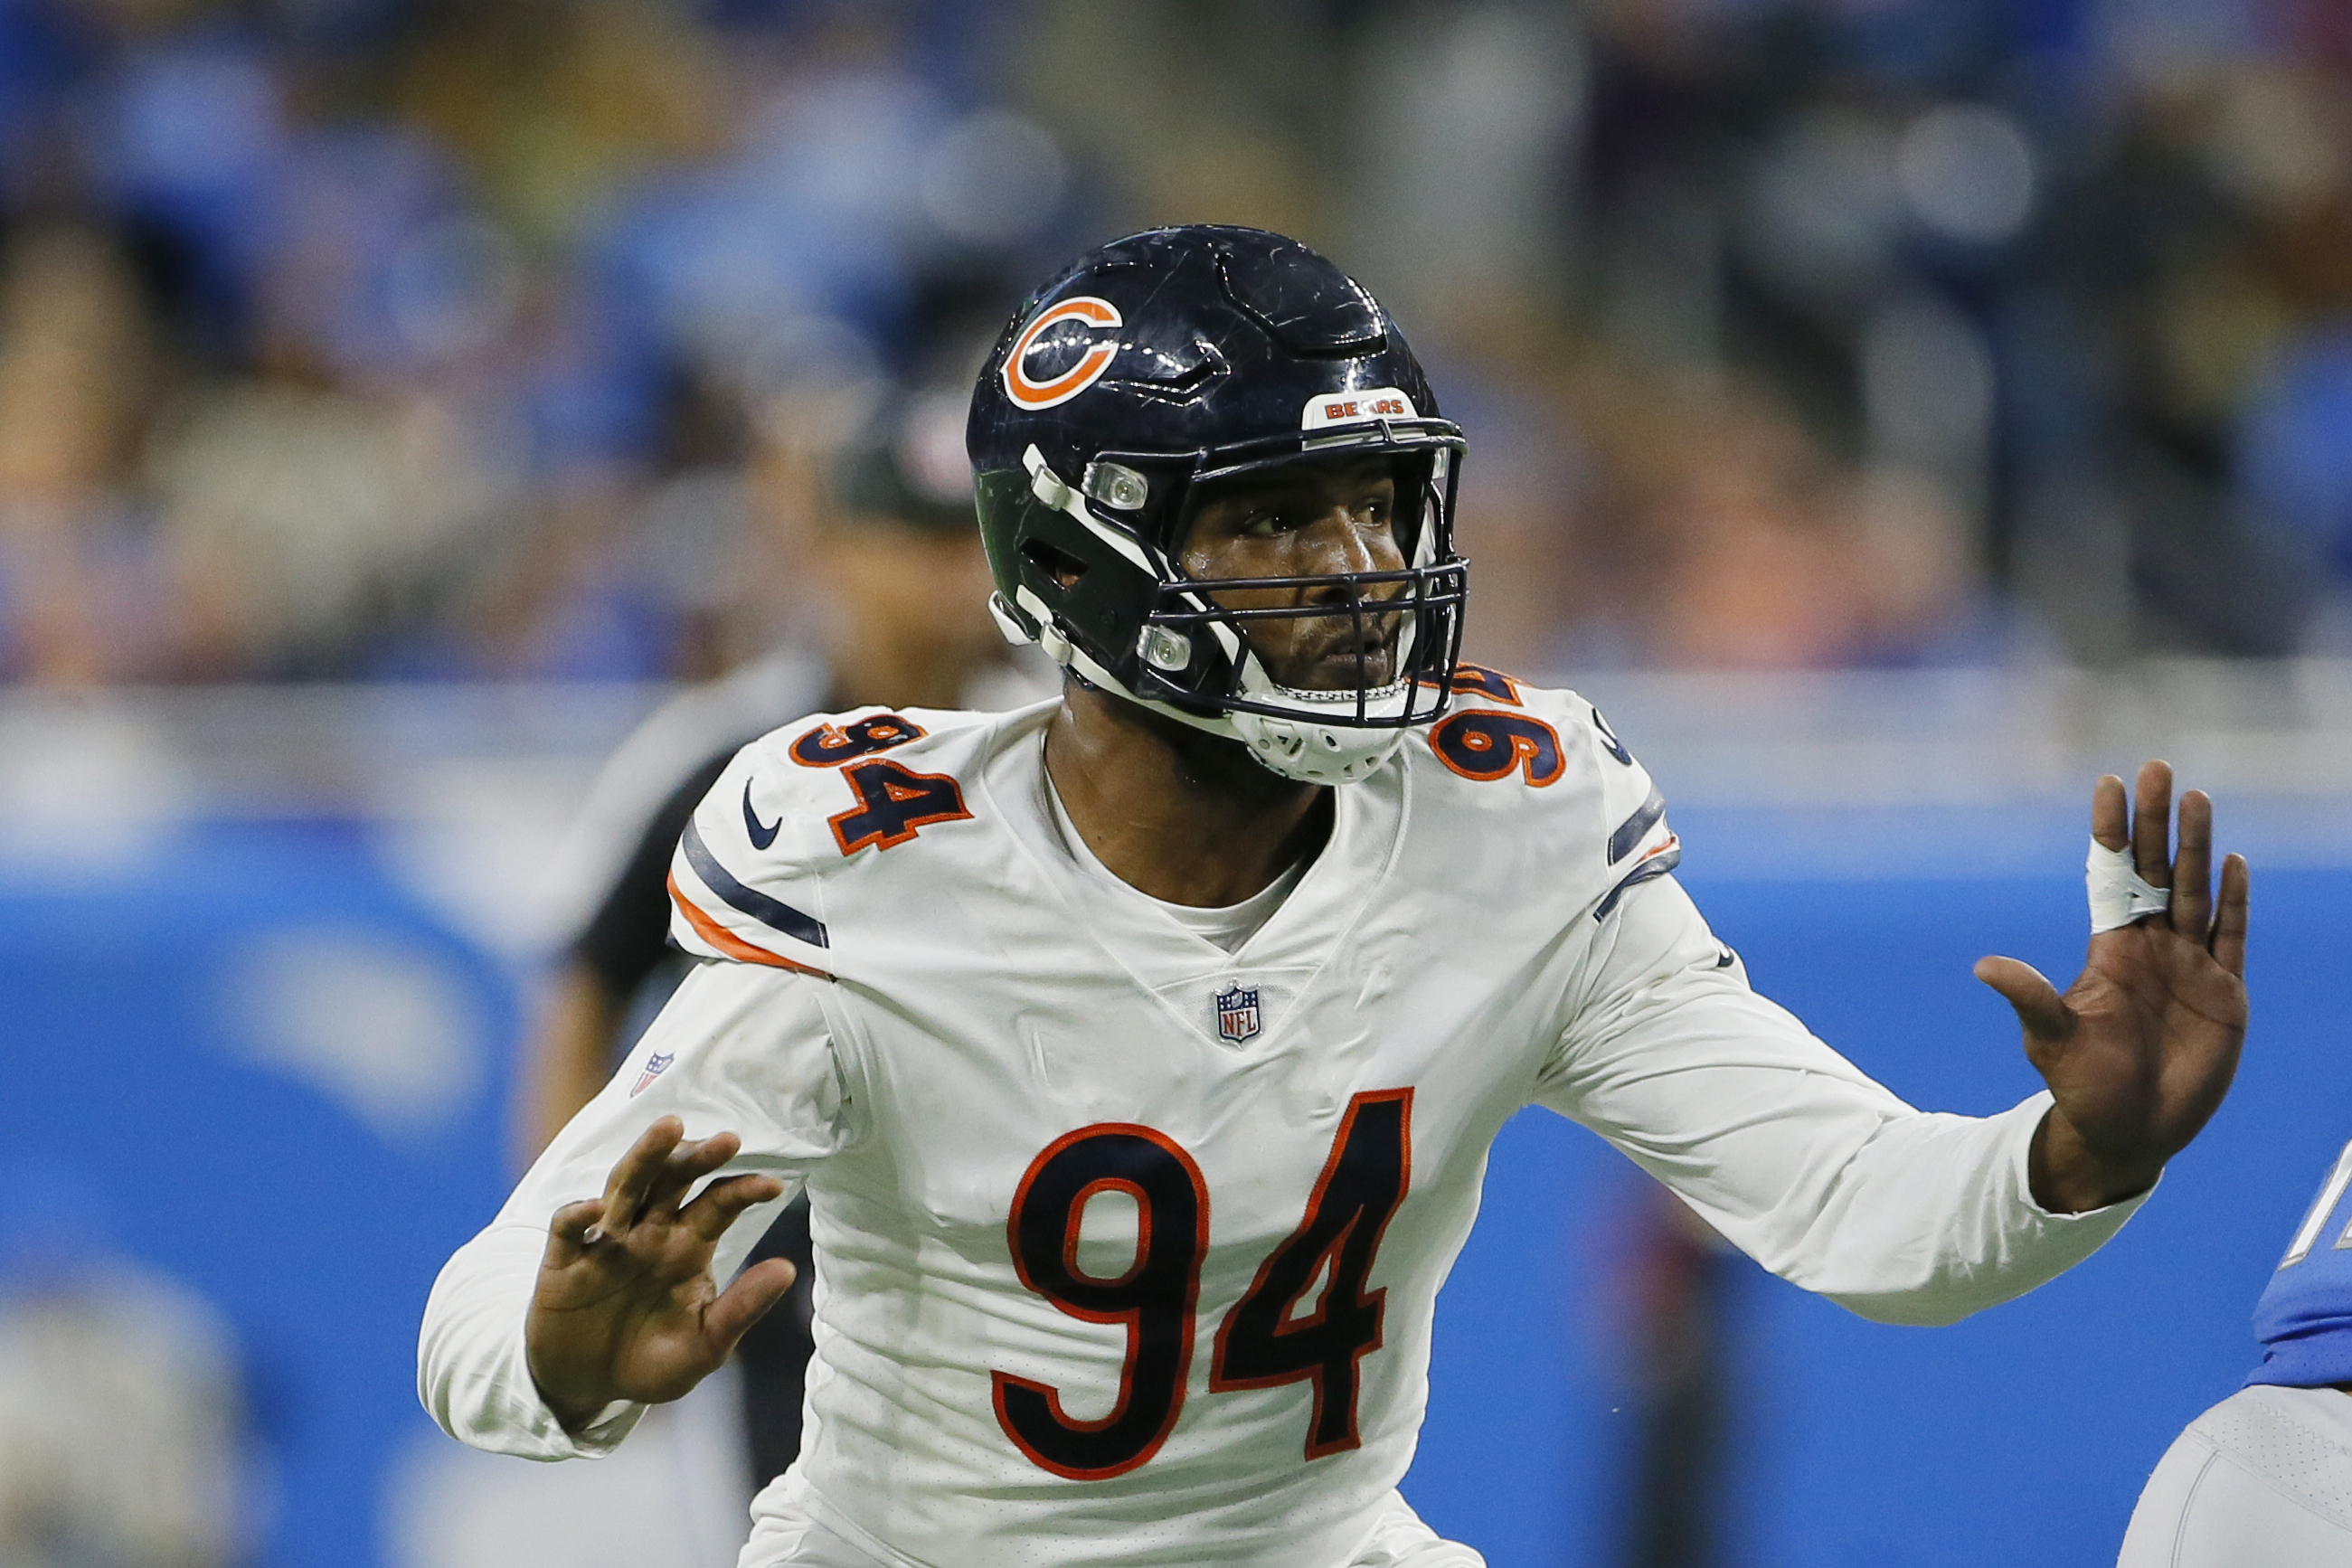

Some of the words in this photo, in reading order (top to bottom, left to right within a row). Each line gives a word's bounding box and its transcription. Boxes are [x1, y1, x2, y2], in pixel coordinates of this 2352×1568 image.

[1000, 297, 1123, 411] C
[789, 713, 974, 856] 94
[1222, 1009, 1257, 1036] NFL
[991, 1086, 1415, 1481] 94
